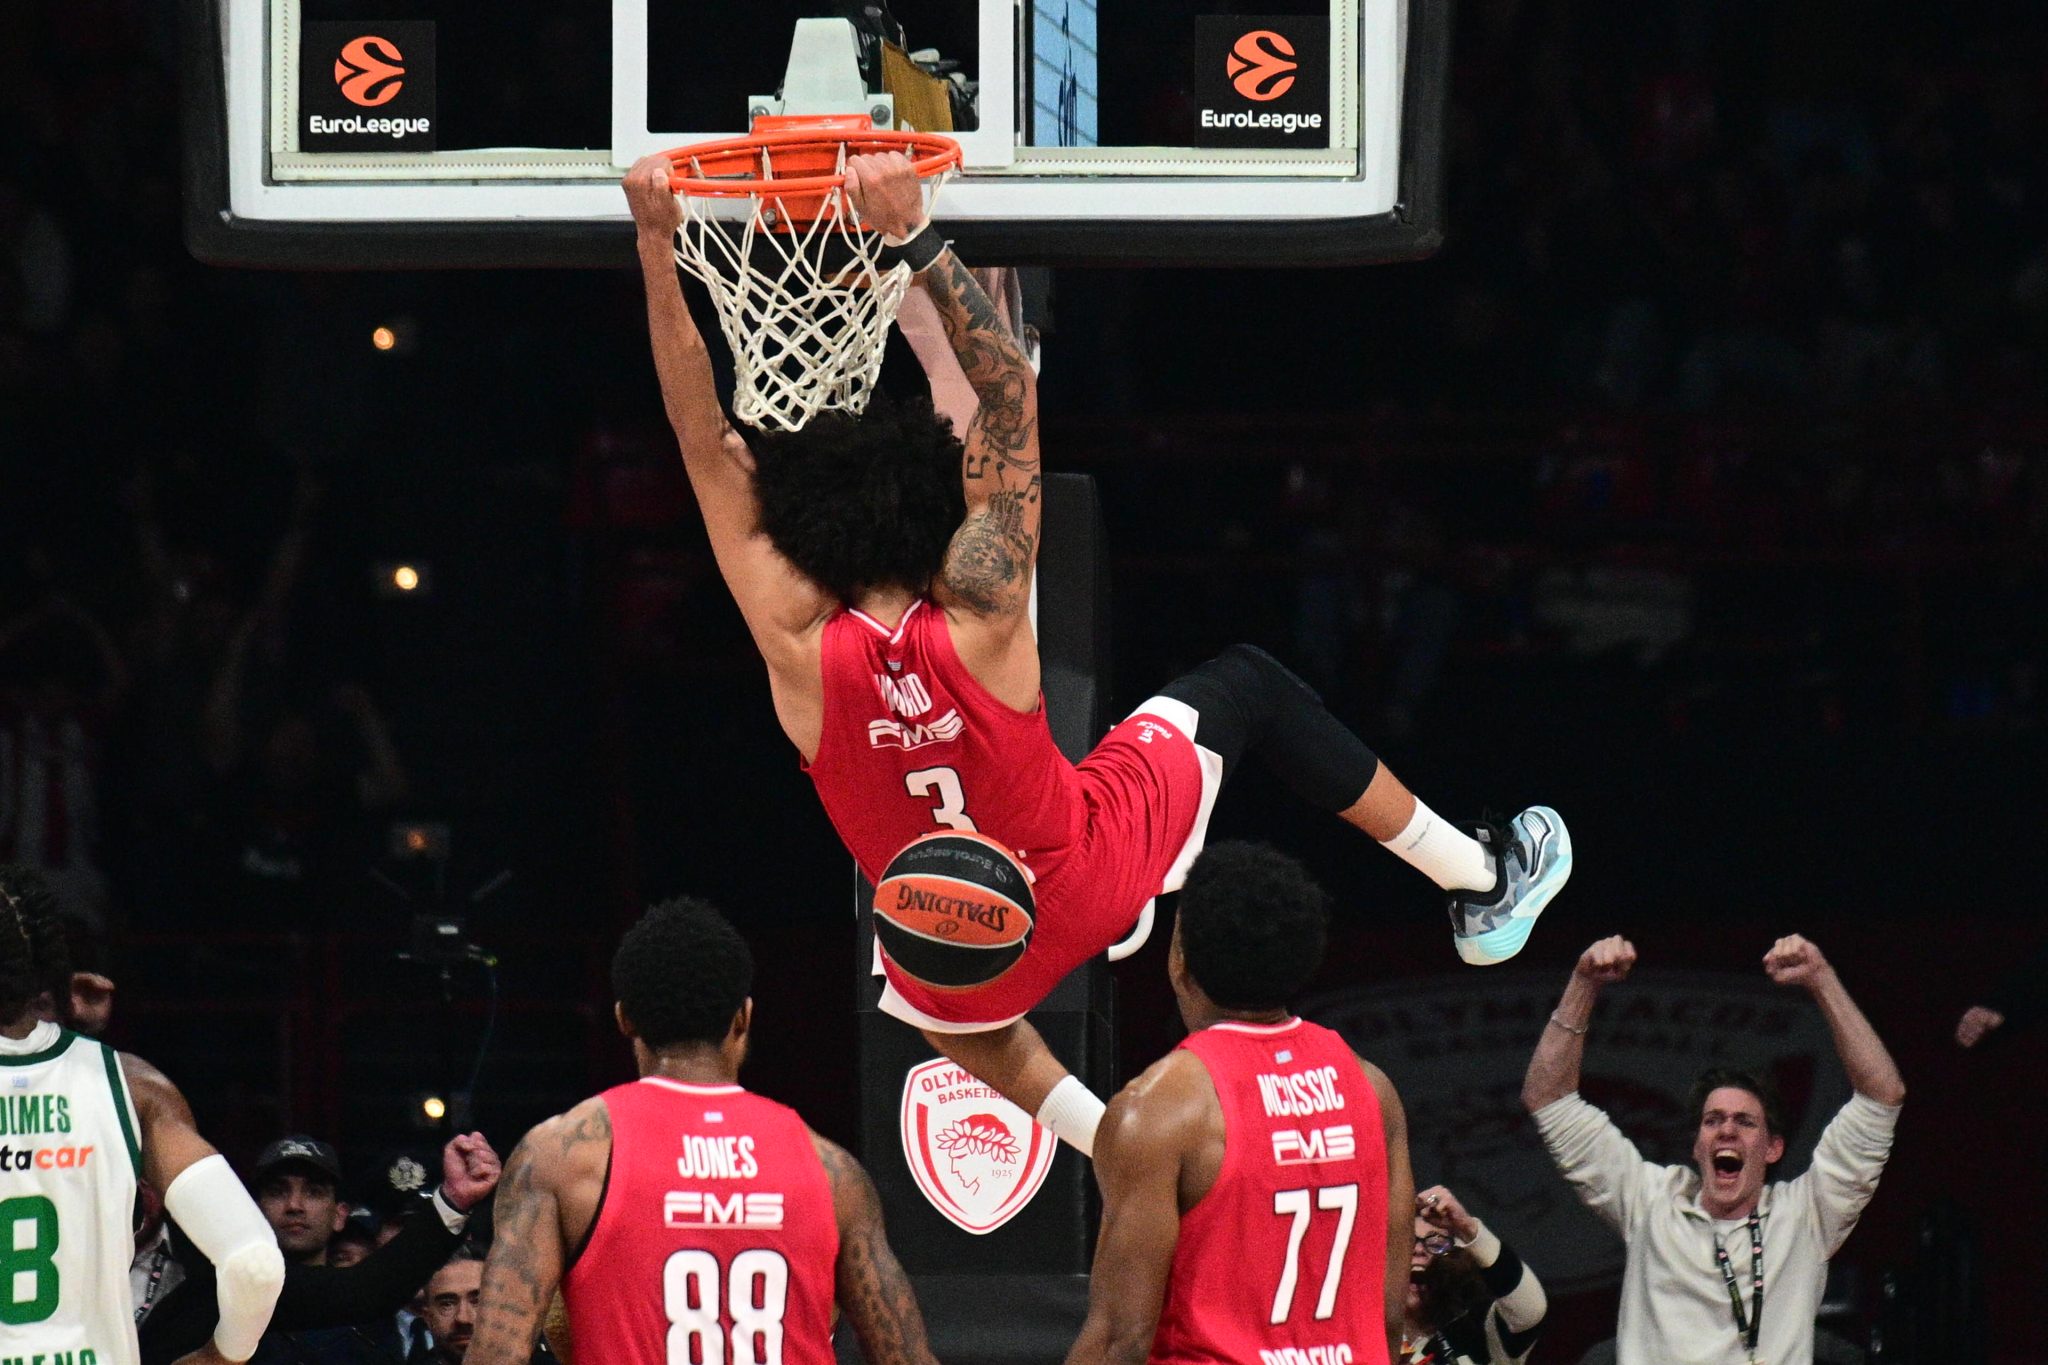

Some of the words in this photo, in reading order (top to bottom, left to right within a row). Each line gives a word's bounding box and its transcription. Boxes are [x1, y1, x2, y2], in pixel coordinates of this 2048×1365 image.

[309, 114, 430, 138] EuroLeague
[1201, 109, 1322, 133] EuroLeague
[868, 708, 966, 751] FMS
[905, 765, 978, 837] 3
[896, 883, 1009, 932] SPALDING
[921, 1070, 978, 1092] OLYM
[677, 1134, 758, 1179] JONES
[1271, 1124, 1356, 1164] FMS
[991, 1168, 1013, 1179] 1925
[663, 1190, 784, 1229] FMS
[1270, 1183, 1359, 1325] 77
[663, 1249, 788, 1365] 88
